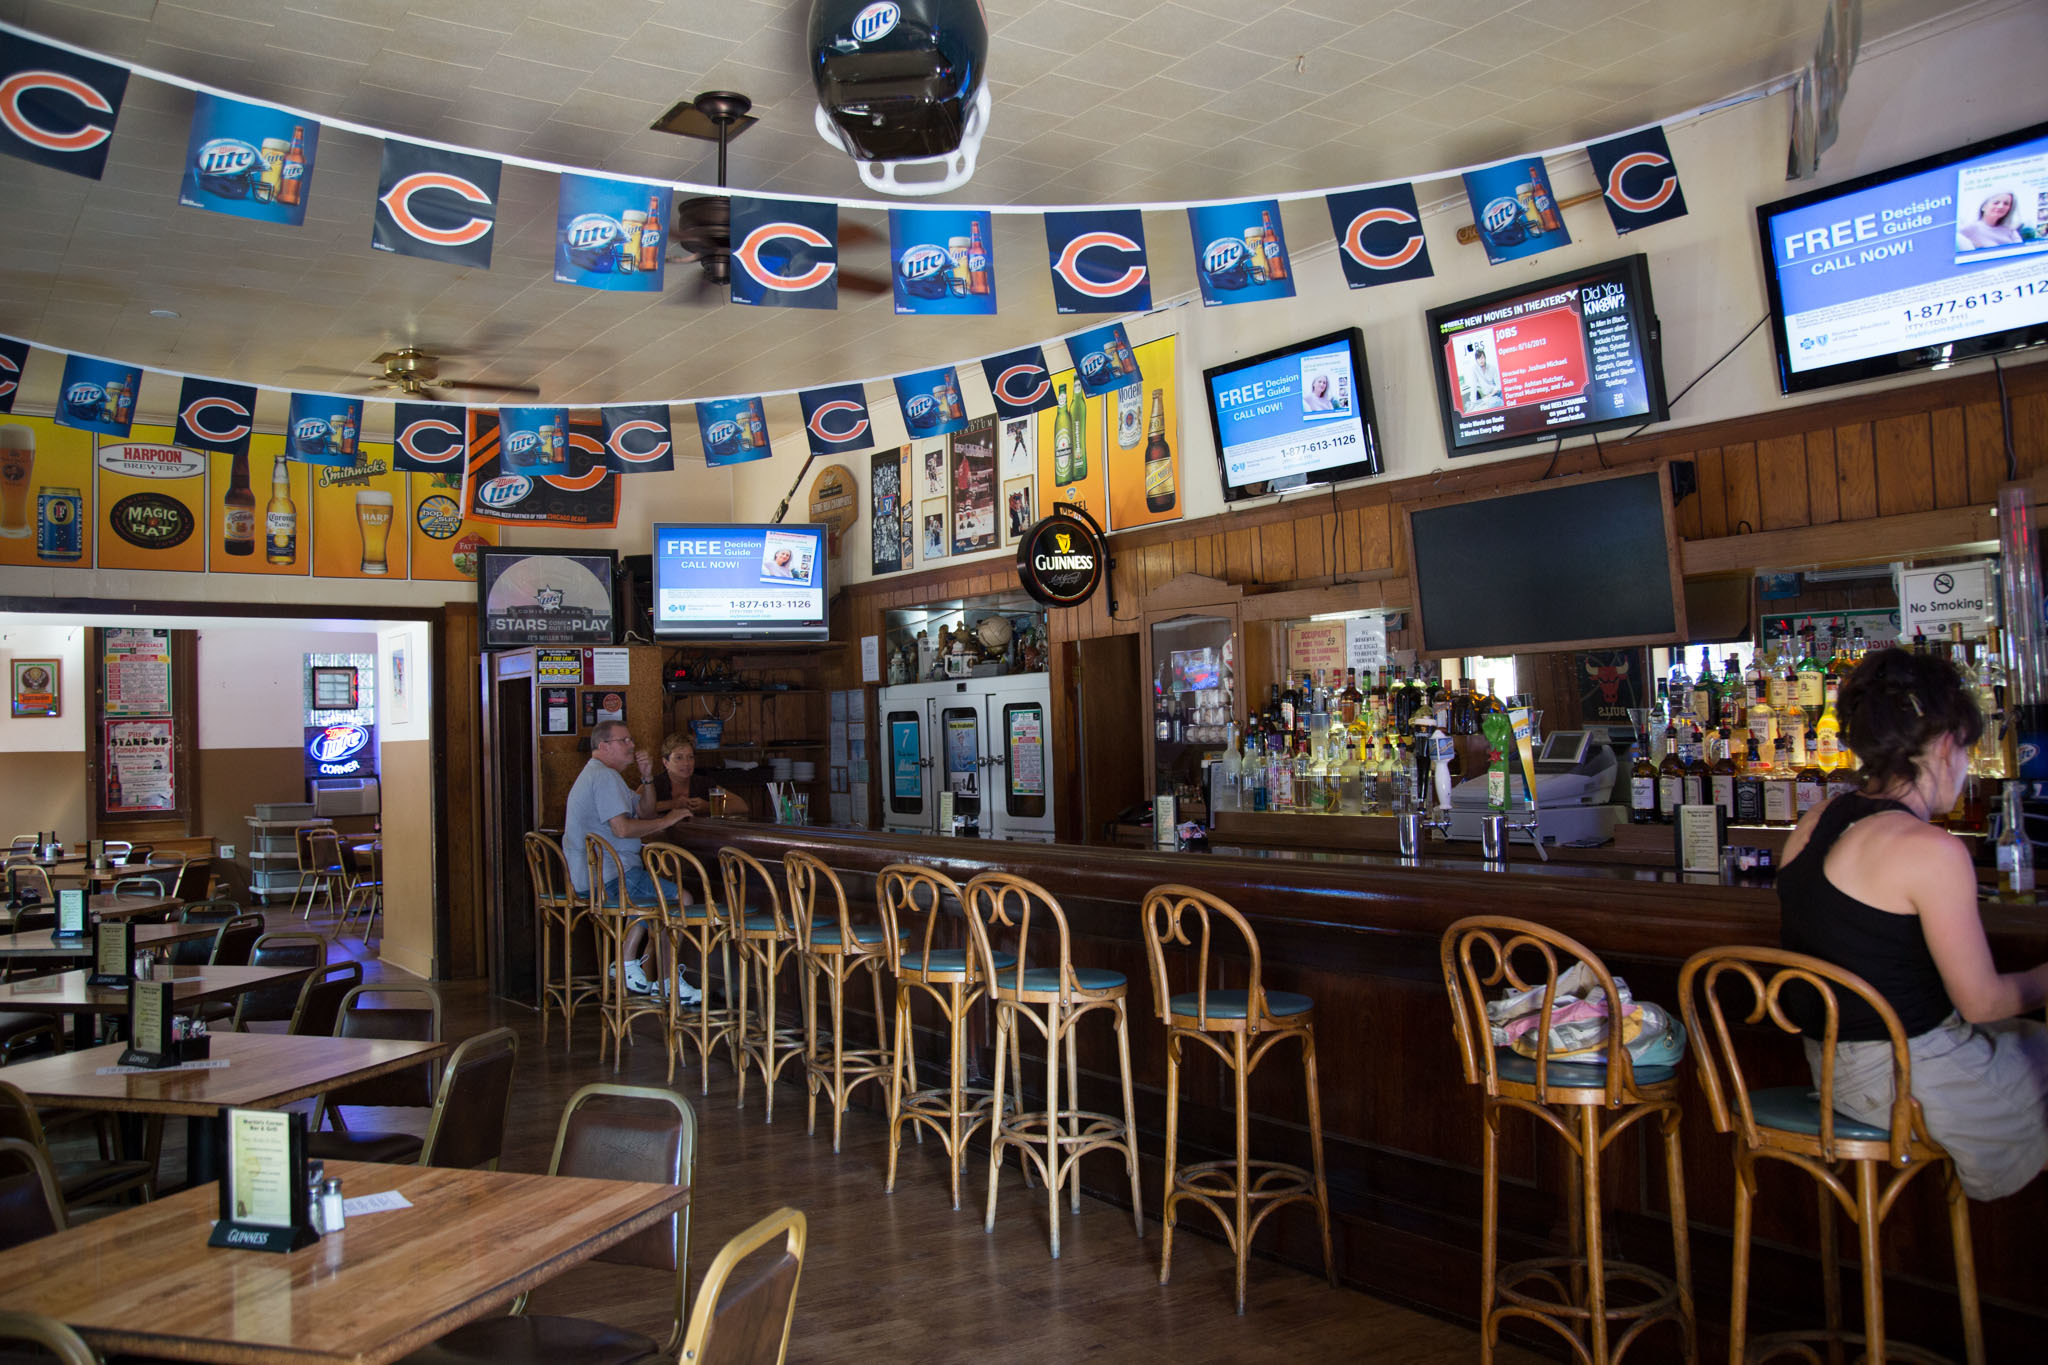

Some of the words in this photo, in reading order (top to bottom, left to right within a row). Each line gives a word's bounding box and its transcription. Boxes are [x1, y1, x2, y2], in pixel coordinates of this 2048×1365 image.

[861, 8, 894, 40] Lite
[204, 151, 251, 175] Lite
[1880, 195, 1952, 223] Decision
[1487, 204, 1514, 232] Lite
[1882, 214, 1933, 236] Guide
[573, 223, 614, 248] Lite
[1784, 213, 1879, 260] FREE
[908, 252, 943, 279] Lite
[1209, 245, 1242, 273] Lite
[1810, 255, 1856, 276] CALL
[1859, 239, 1914, 265] NOW!
[1582, 286, 1600, 302] Did
[1601, 283, 1624, 301] You
[1903, 279, 2048, 323] 1-877-613-112
[1464, 315, 1482, 327] NEW
[1483, 307, 1513, 323] MOVIES
[1514, 304, 1523, 315] IN
[1524, 293, 1567, 311] THEATERS
[1084, 355, 1105, 373] Lite
[1265, 373, 1299, 389] Decision
[71, 388, 100, 404] Lite
[1219, 382, 1266, 408] FREE
[1267, 385, 1291, 397] Guide
[909, 398, 932, 417] Lite
[1233, 409, 1256, 421] CALL
[1257, 402, 1283, 415] NOW!
[297, 424, 324, 439] Lite
[710, 425, 735, 443] Lite
[510, 436, 535, 451] Lite
[1281, 434, 1356, 459] 1-877-613-1126
[123, 447, 182, 464] HARPOON
[123, 462, 182, 472] BREWERY
[319, 459, 388, 489] Smithwick's
[496, 477, 519, 488] Miller
[488, 482, 525, 503] Lite
[128, 506, 178, 523] MAGIC
[362, 513, 389, 523] HARP
[422, 509, 443, 519] hop
[131, 524, 172, 537] HAT
[667, 540, 722, 555] FREE
[681, 561, 707, 569] CALL
[710, 561, 740, 569] NOW!
[1035, 555, 1093, 570] GUINNESS
[729, 601, 811, 609] 1-877-613-1126
[1909, 603, 1927, 614] No
[1930, 598, 1984, 613] Smoking
[496, 618, 547, 631] STARS
[572, 620, 609, 631] PLAY
[1326, 637, 1336, 646] 59
[111, 737, 169, 746] STAND-UP
[322, 732, 361, 760] Lite
[320, 760, 360, 774] CORNER
[228, 1229, 269, 1244] GUINNESS
